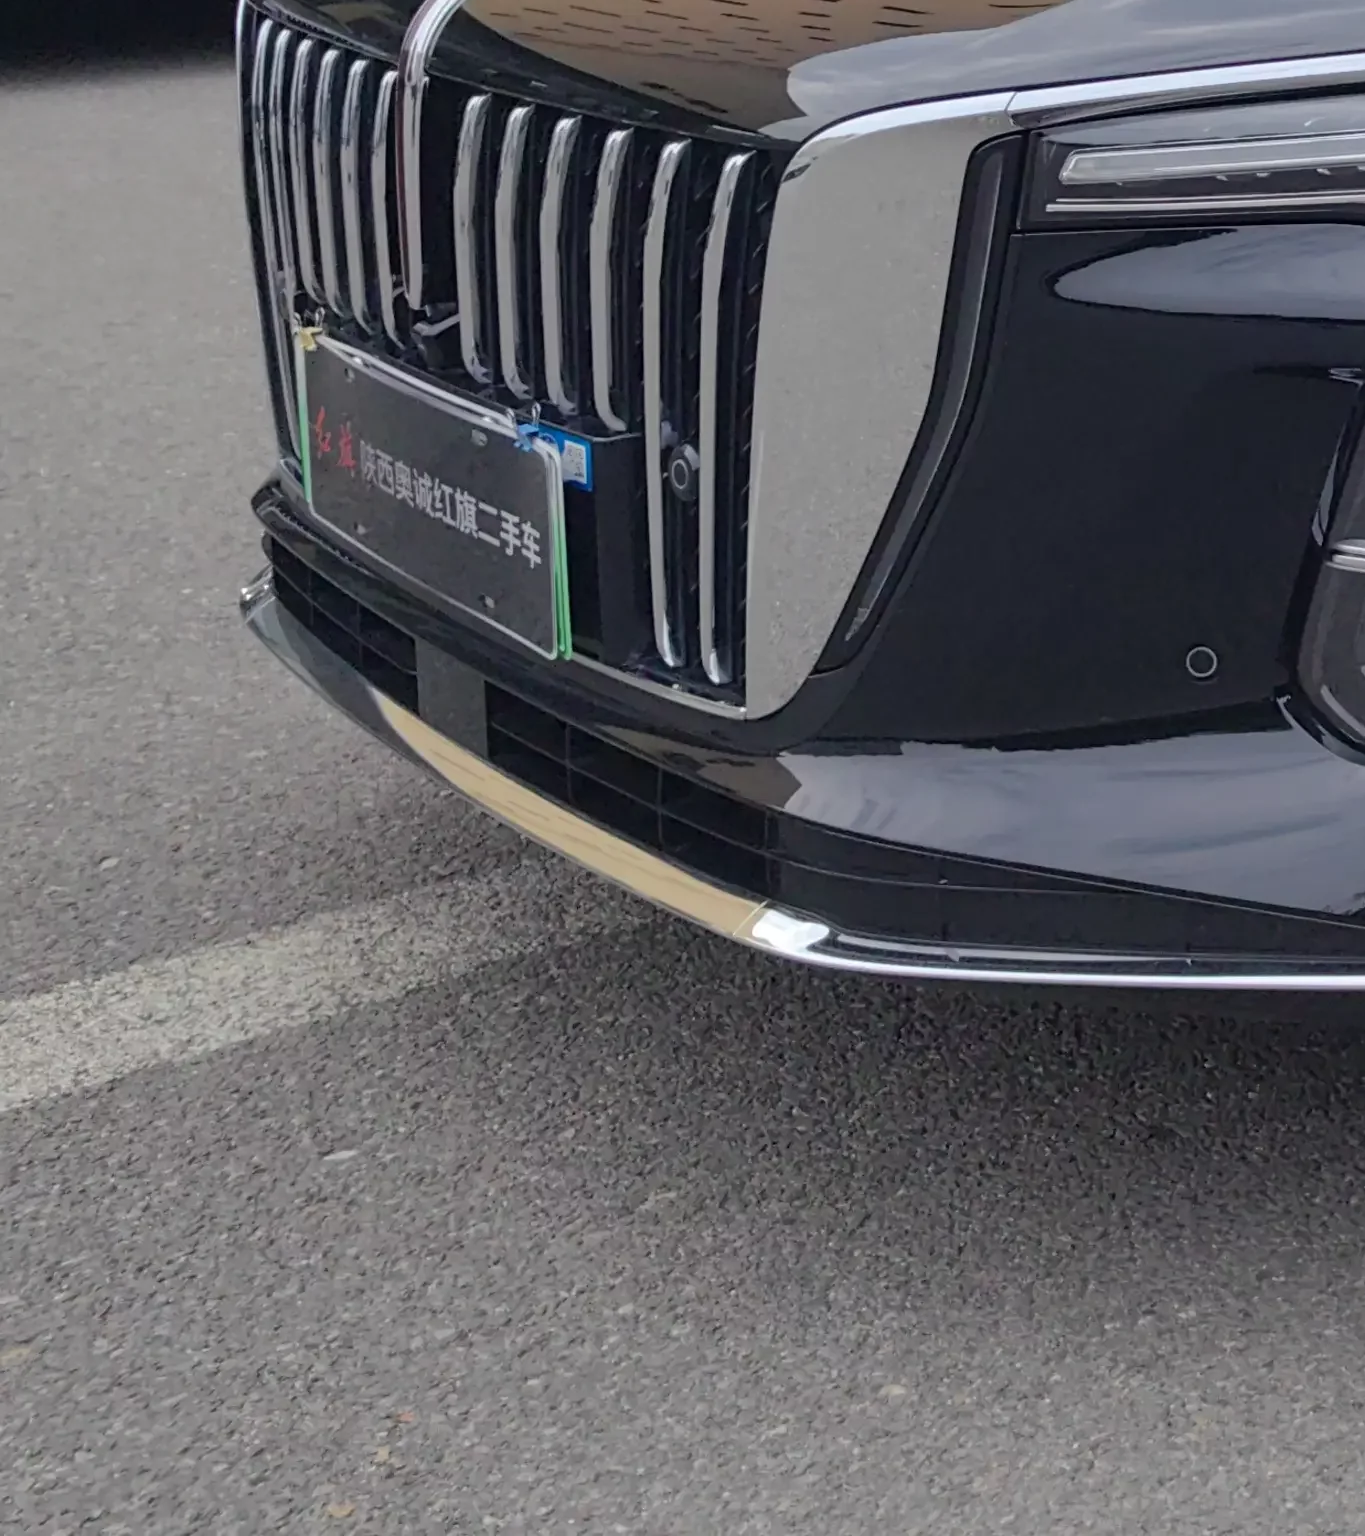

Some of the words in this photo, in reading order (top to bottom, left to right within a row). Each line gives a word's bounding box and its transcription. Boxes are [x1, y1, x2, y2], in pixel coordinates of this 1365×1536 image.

[360, 440, 541, 569] 陕西奥诚红旗二手车
